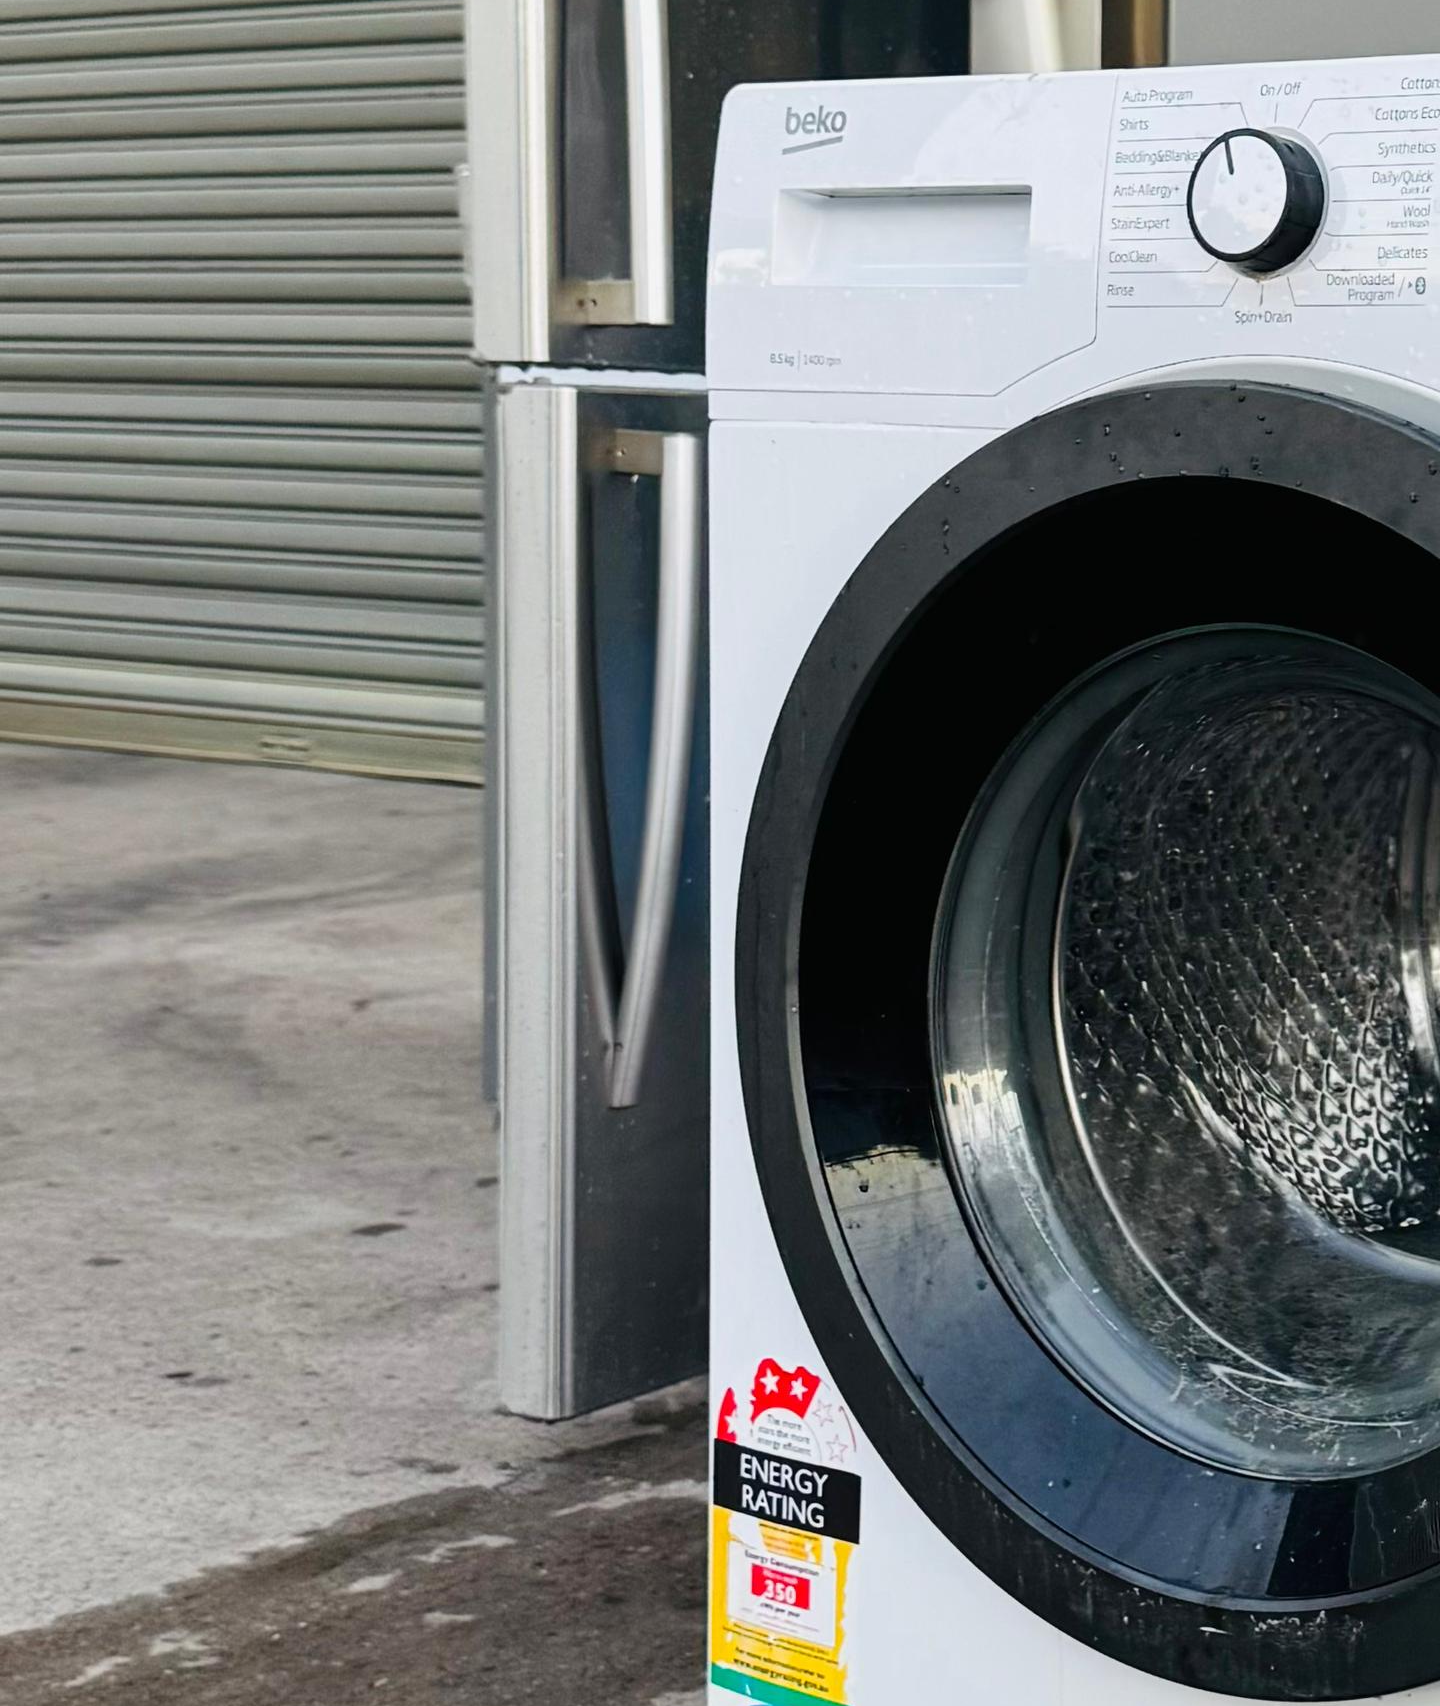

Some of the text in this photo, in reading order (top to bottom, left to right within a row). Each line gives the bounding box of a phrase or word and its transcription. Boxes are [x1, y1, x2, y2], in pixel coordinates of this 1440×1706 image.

[1122, 90, 1193, 103] Auto Program
[785, 105, 847, 135] beko
[1375, 107, 1440, 121] Cottons Eco
[1119, 118, 1149, 131] Shirts
[1377, 141, 1437, 156] Synthetics
[1372, 170, 1433, 186] Daily/Quick
[1113, 183, 1180, 198] Anti-Allergy+
[1403, 204, 1430, 217] Wool
[1111, 217, 1170, 231] StainExpert
[1109, 251, 1157, 264] CoolClean
[1377, 246, 1428, 260] Delicates
[1327, 273, 1395, 287] Downloaded
[1107, 284, 1135, 297] Rinse
[1348, 288, 1395, 303] Program
[740, 1453, 828, 1497] ENERGY
[741, 1484, 825, 1529] RATING
[764, 1579, 797, 1605] 350
